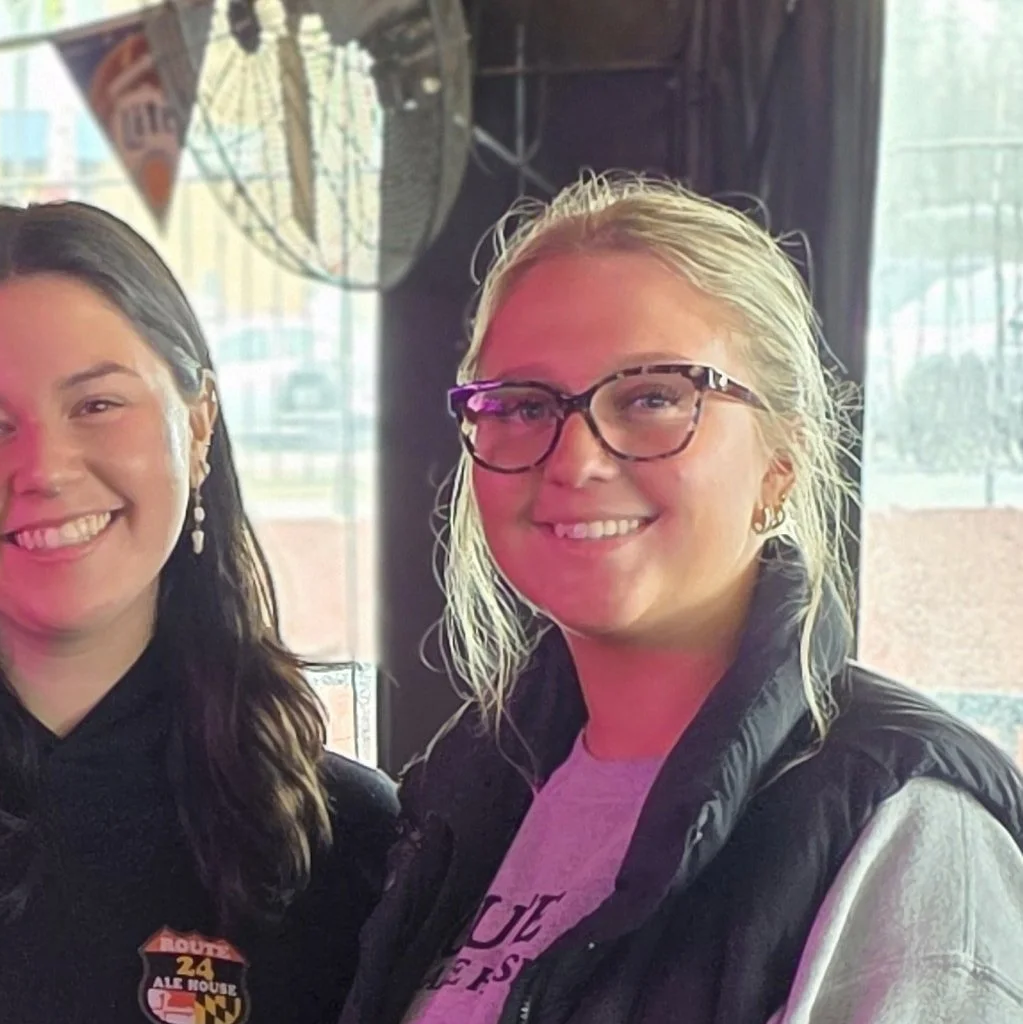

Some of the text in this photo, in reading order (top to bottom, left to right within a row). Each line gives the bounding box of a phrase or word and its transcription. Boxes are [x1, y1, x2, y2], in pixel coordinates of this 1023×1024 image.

[159, 937, 234, 960] ROUTE
[176, 955, 214, 980] 24
[153, 976, 238, 997] ALE HOUSE
